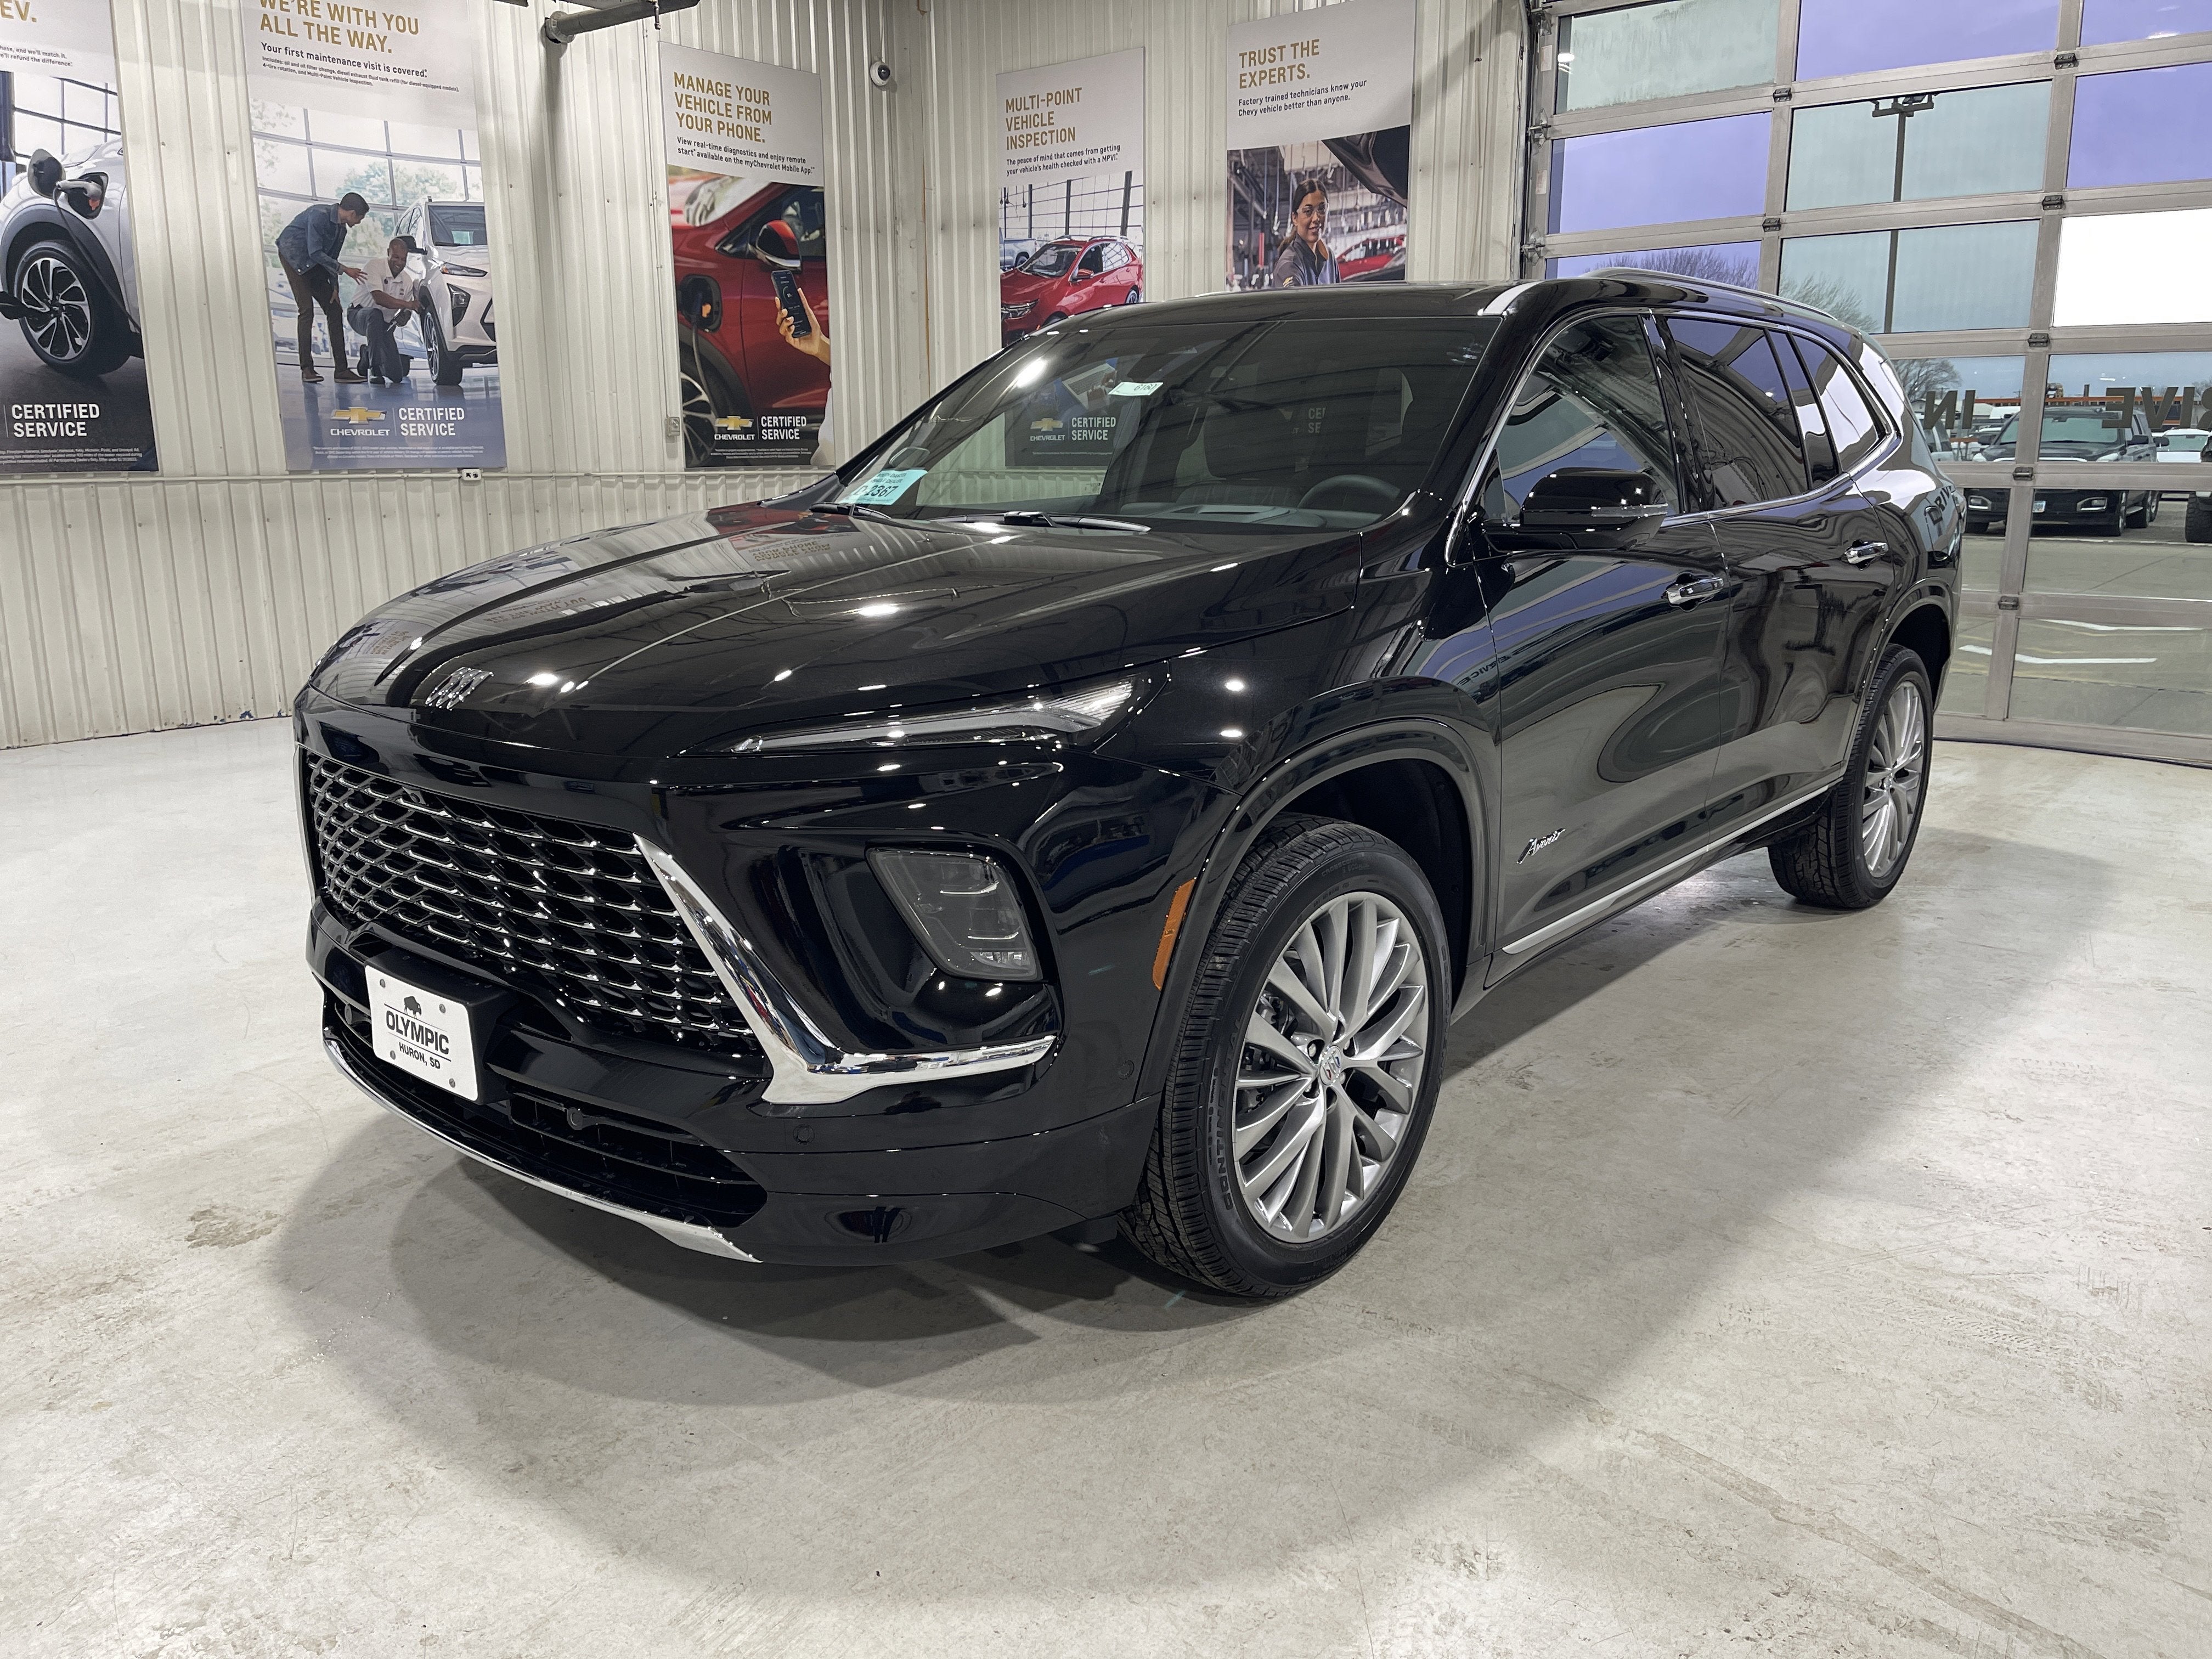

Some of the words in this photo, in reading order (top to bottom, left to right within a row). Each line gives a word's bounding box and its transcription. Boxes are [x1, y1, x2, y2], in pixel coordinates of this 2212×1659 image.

[1, 0, 37, 22] EV.
[328, 2, 377, 29] WITH
[382, 13, 419, 35] YOU
[260, 13, 298, 37] ALL
[303, 21, 341, 45] THE
[347, 29, 392, 54] WAY.
[261, 42, 281, 54] Your
[284, 47, 304, 59] first
[307, 52, 362, 68] maintenance
[363, 61, 381, 72] visit
[383, 64, 391, 72] is
[1239, 45, 1286, 69] TRUST
[1290, 39, 1319, 58] THE
[1239, 63, 1310, 89] EXPERTS.
[674, 72, 732, 99] MANAGE
[736, 85, 770, 106] YOUR
[1006, 87, 1082, 113] MULTI-POINT
[1238, 96, 1263, 106] Factory
[1265, 92, 1289, 103] trained
[1290, 87, 1329, 99] technicians
[1330, 82, 1349, 93] know
[1351, 80, 1367, 91] your
[674, 92, 732, 119] VEHICLE
[737, 105, 772, 125] FROM
[1238, 108, 1258, 117] Chevy
[1259, 104, 1283, 114] vehicle
[1284, 101, 1305, 111] better
[1307, 98, 1322, 108] than
[1324, 93, 1351, 106] anyone.
[676, 112, 713, 134] YOUR
[717, 121, 765, 143] PHONE.
[1006, 111, 1054, 132] VEHICLE
[677, 137, 692, 145] View
[693, 140, 722, 151] real-time
[724, 145, 757, 158] diagnostics
[758, 150, 769, 159] and
[770, 154, 785, 163] enjoy
[1006, 127, 1075, 150] INSPECTION
[697, 151, 723, 161] available
[744, 159, 780, 171] myChevrolet
[782, 165, 799, 173] Mobile
[1017, 157, 1032, 166] peace
[1085, 148, 1098, 156] from
[1100, 144, 1120, 155] getting
[1006, 168, 1018, 177] your
[1019, 164, 1041, 173] vehicle's
[1042, 162, 1059, 171] health
[1060, 159, 1082, 168] checked
[1084, 157, 1096, 165] with
[12, 404, 100, 420] CERTIFIED
[398, 408, 465, 421] CERTIFIED
[761, 416, 807, 427] CERTIFIED
[1071, 417, 1116, 427] CERTIFIED
[13, 421, 87, 438] SERVICE
[400, 423, 456, 436] SERVICE
[761, 429, 800, 440] SERVICE
[1071, 430, 1108, 441] SERVICE
[386, 1010, 449, 1055] OLYMPIC
[399, 1042, 427, 1066] HURON,
[430, 1057, 441, 1069] SD
